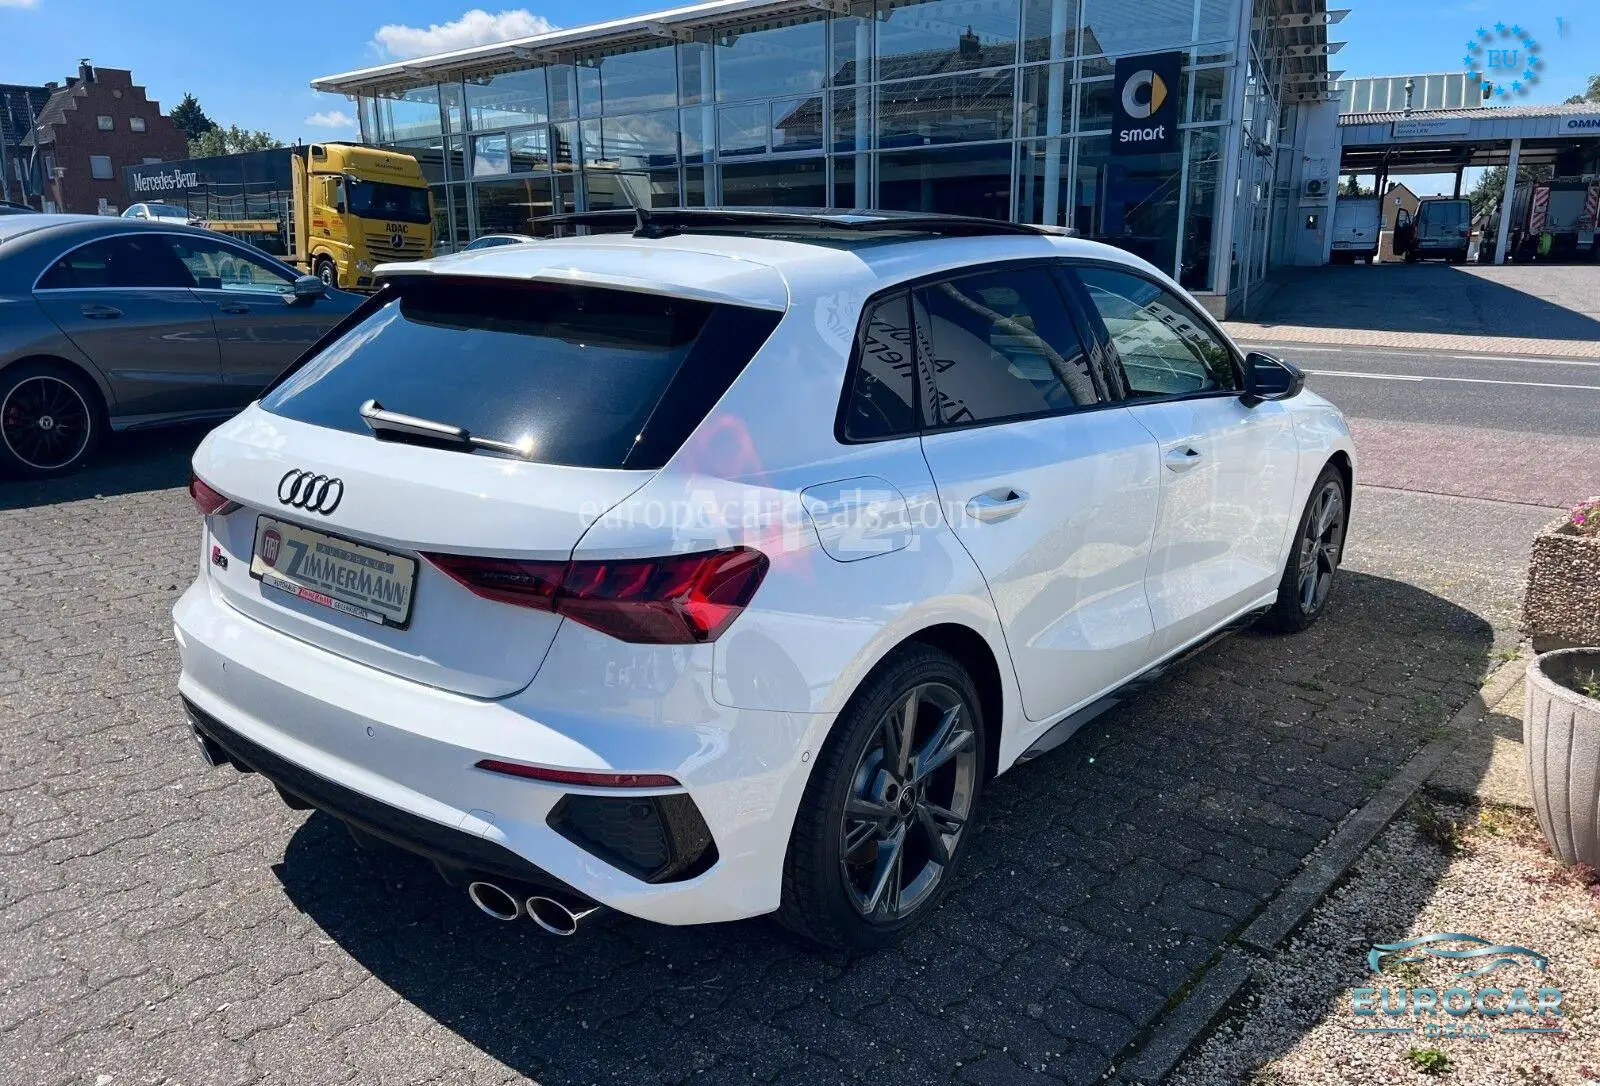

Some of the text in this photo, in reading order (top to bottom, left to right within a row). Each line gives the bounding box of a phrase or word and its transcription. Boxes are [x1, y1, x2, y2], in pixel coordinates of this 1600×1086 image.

[1119, 124, 1165, 143] smart
[133, 169, 198, 192] Mercedes-Benz
[385, 222, 409, 235] ADAC
[264, 536, 280, 562] FIAT
[286, 539, 407, 607] ZIMMERMANN
